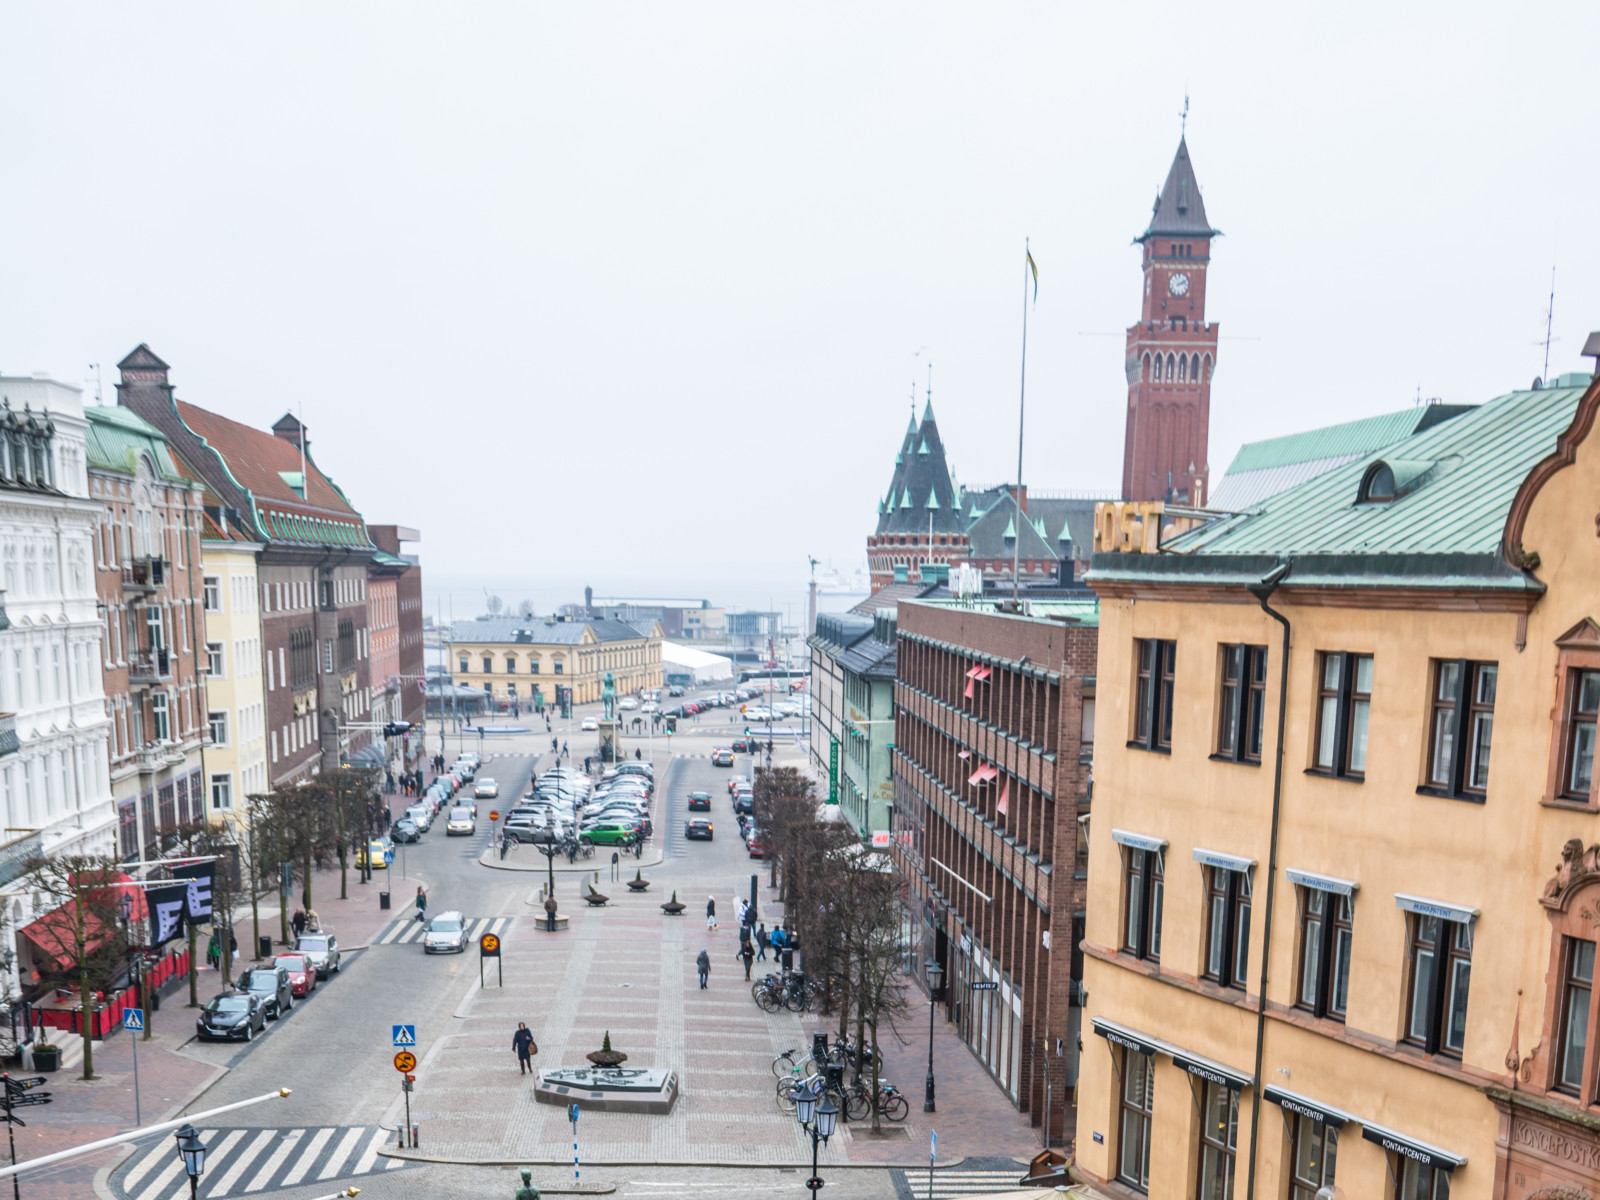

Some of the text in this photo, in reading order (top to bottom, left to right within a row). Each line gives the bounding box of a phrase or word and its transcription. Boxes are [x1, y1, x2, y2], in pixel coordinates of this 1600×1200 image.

[1107, 1032, 1140, 1052] KONTAKTCENTER
[1187, 1064, 1226, 1085] KONTAKTCENTER
[1281, 1099, 1324, 1122] KONTAKTCENTER
[1382, 1138, 1431, 1164] KONTAKTCENTER
